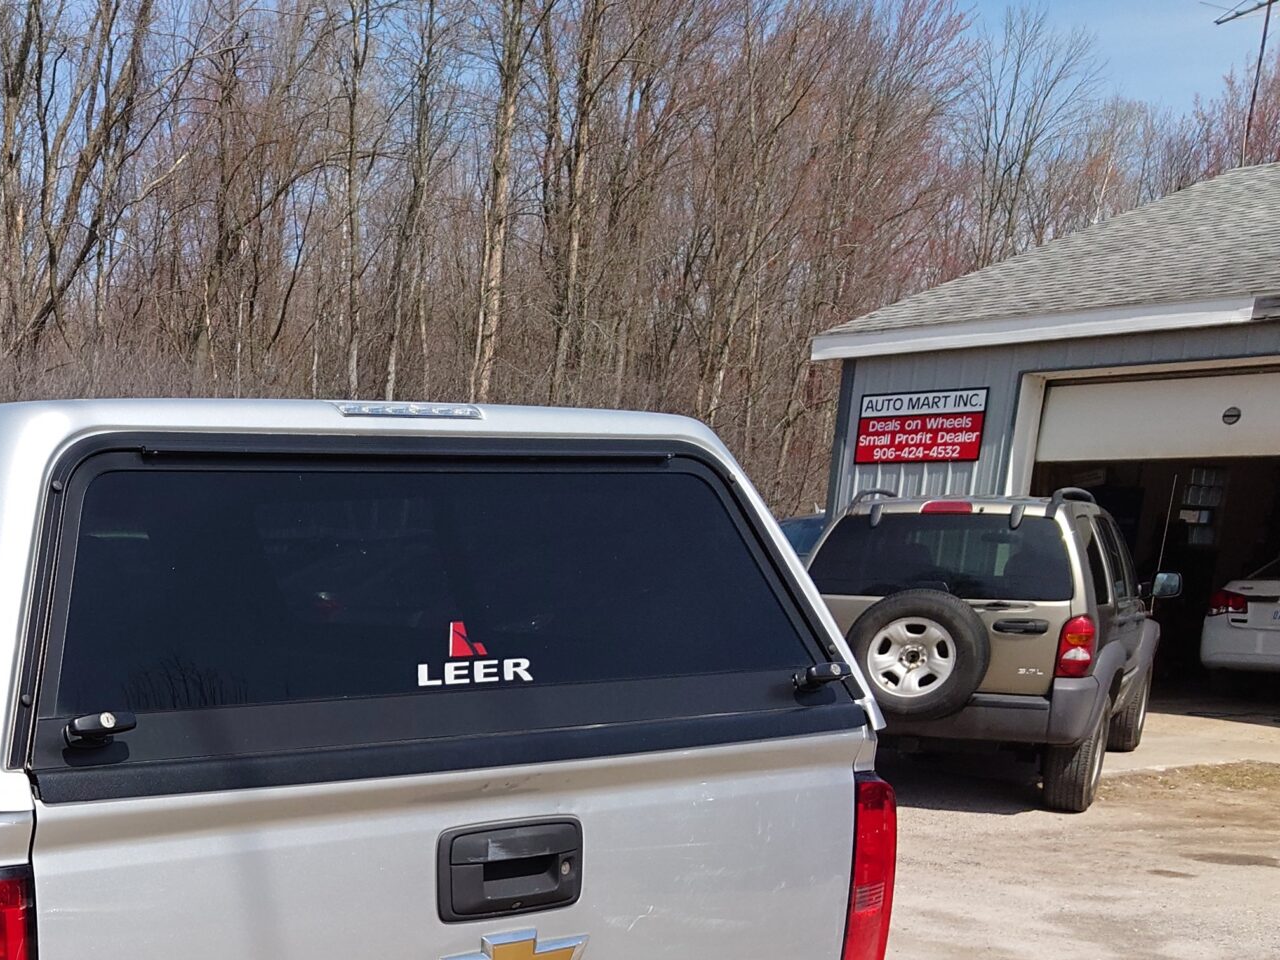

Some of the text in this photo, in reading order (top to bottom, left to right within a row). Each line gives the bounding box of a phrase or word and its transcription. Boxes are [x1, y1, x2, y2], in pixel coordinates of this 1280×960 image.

[864, 393, 982, 412] AUTO MART INC.
[868, 416, 972, 432] Deals on Wheels
[859, 430, 980, 446] Small Profit Dealer
[873, 446, 960, 459] 906-424-4532
[417, 658, 533, 686] LEER
